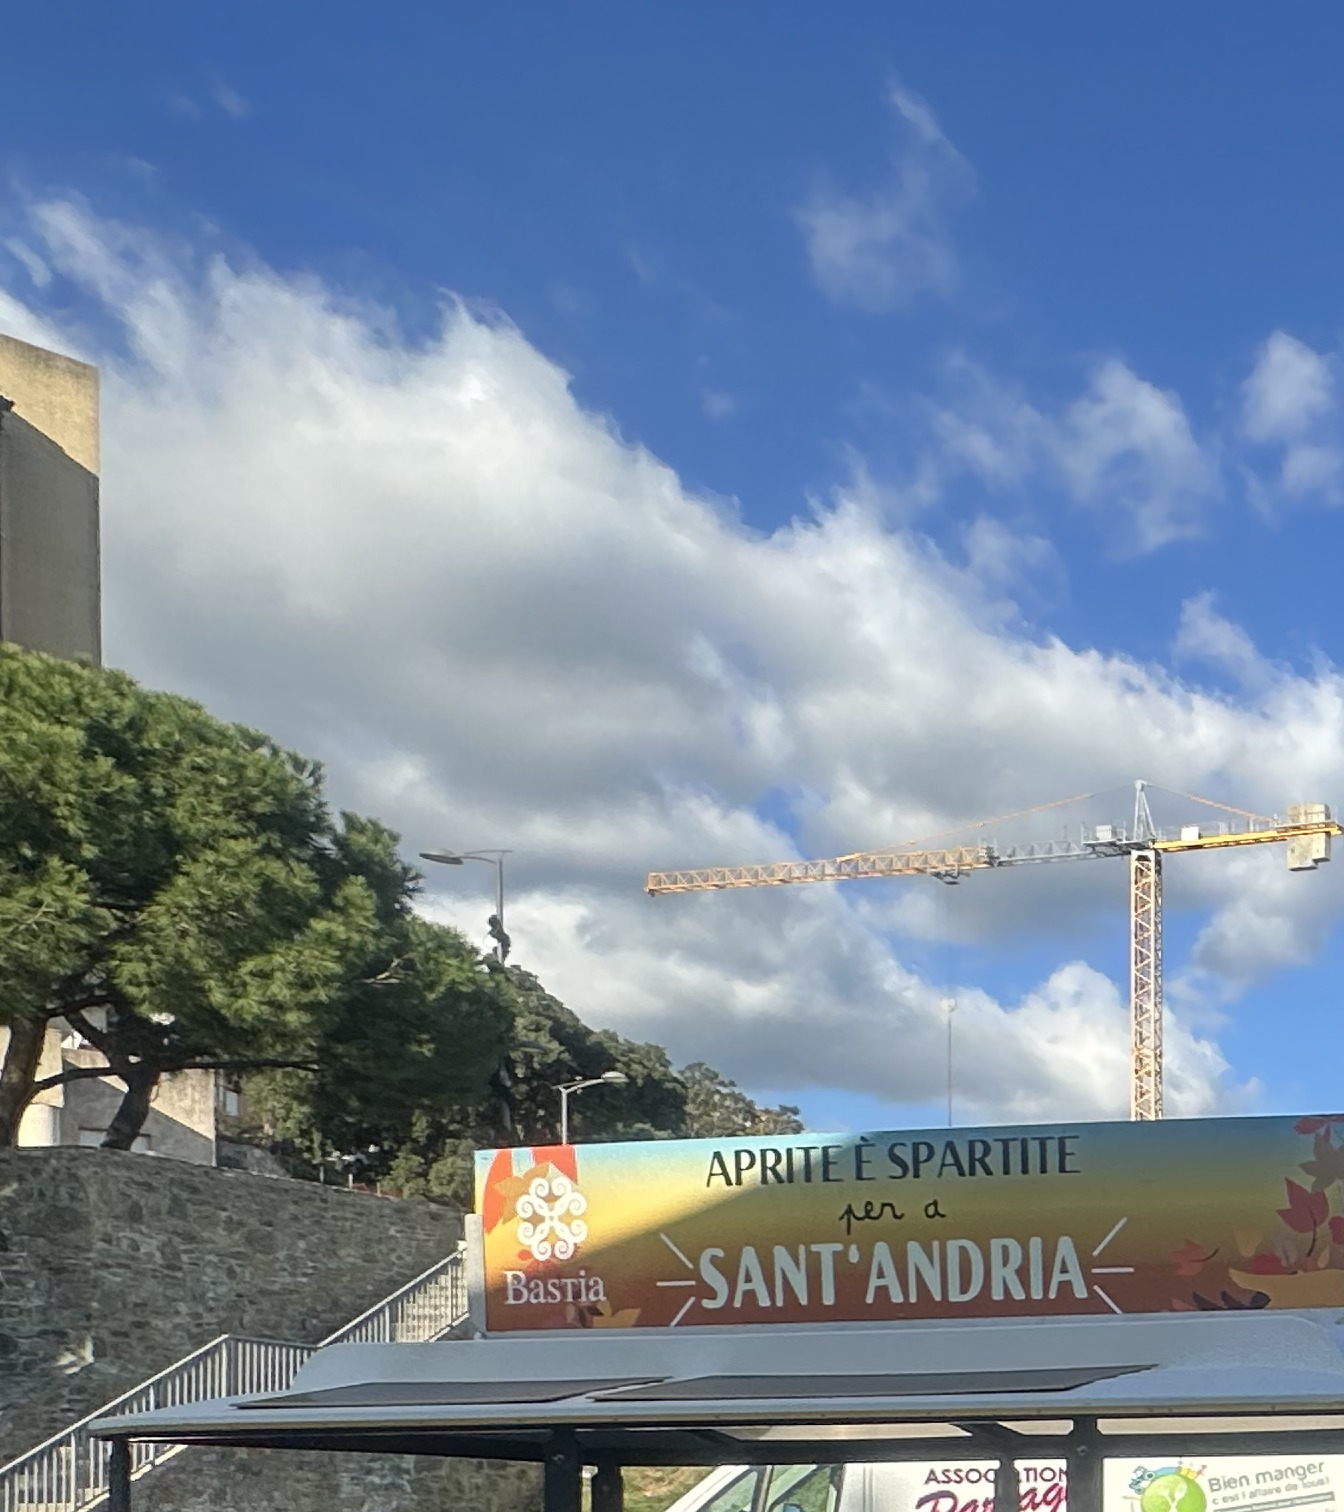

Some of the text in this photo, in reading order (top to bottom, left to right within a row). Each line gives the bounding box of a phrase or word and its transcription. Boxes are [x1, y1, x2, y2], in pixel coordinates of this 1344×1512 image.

[706, 1135, 1082, 1188] APRITE È SPARTITE
[839, 1199, 947, 1236] per a
[503, 1270, 607, 1305] Bastia
[700, 1235, 1088, 1309] SANT'ANDRIA
[1207, 1461, 1325, 1493] Bien manger
